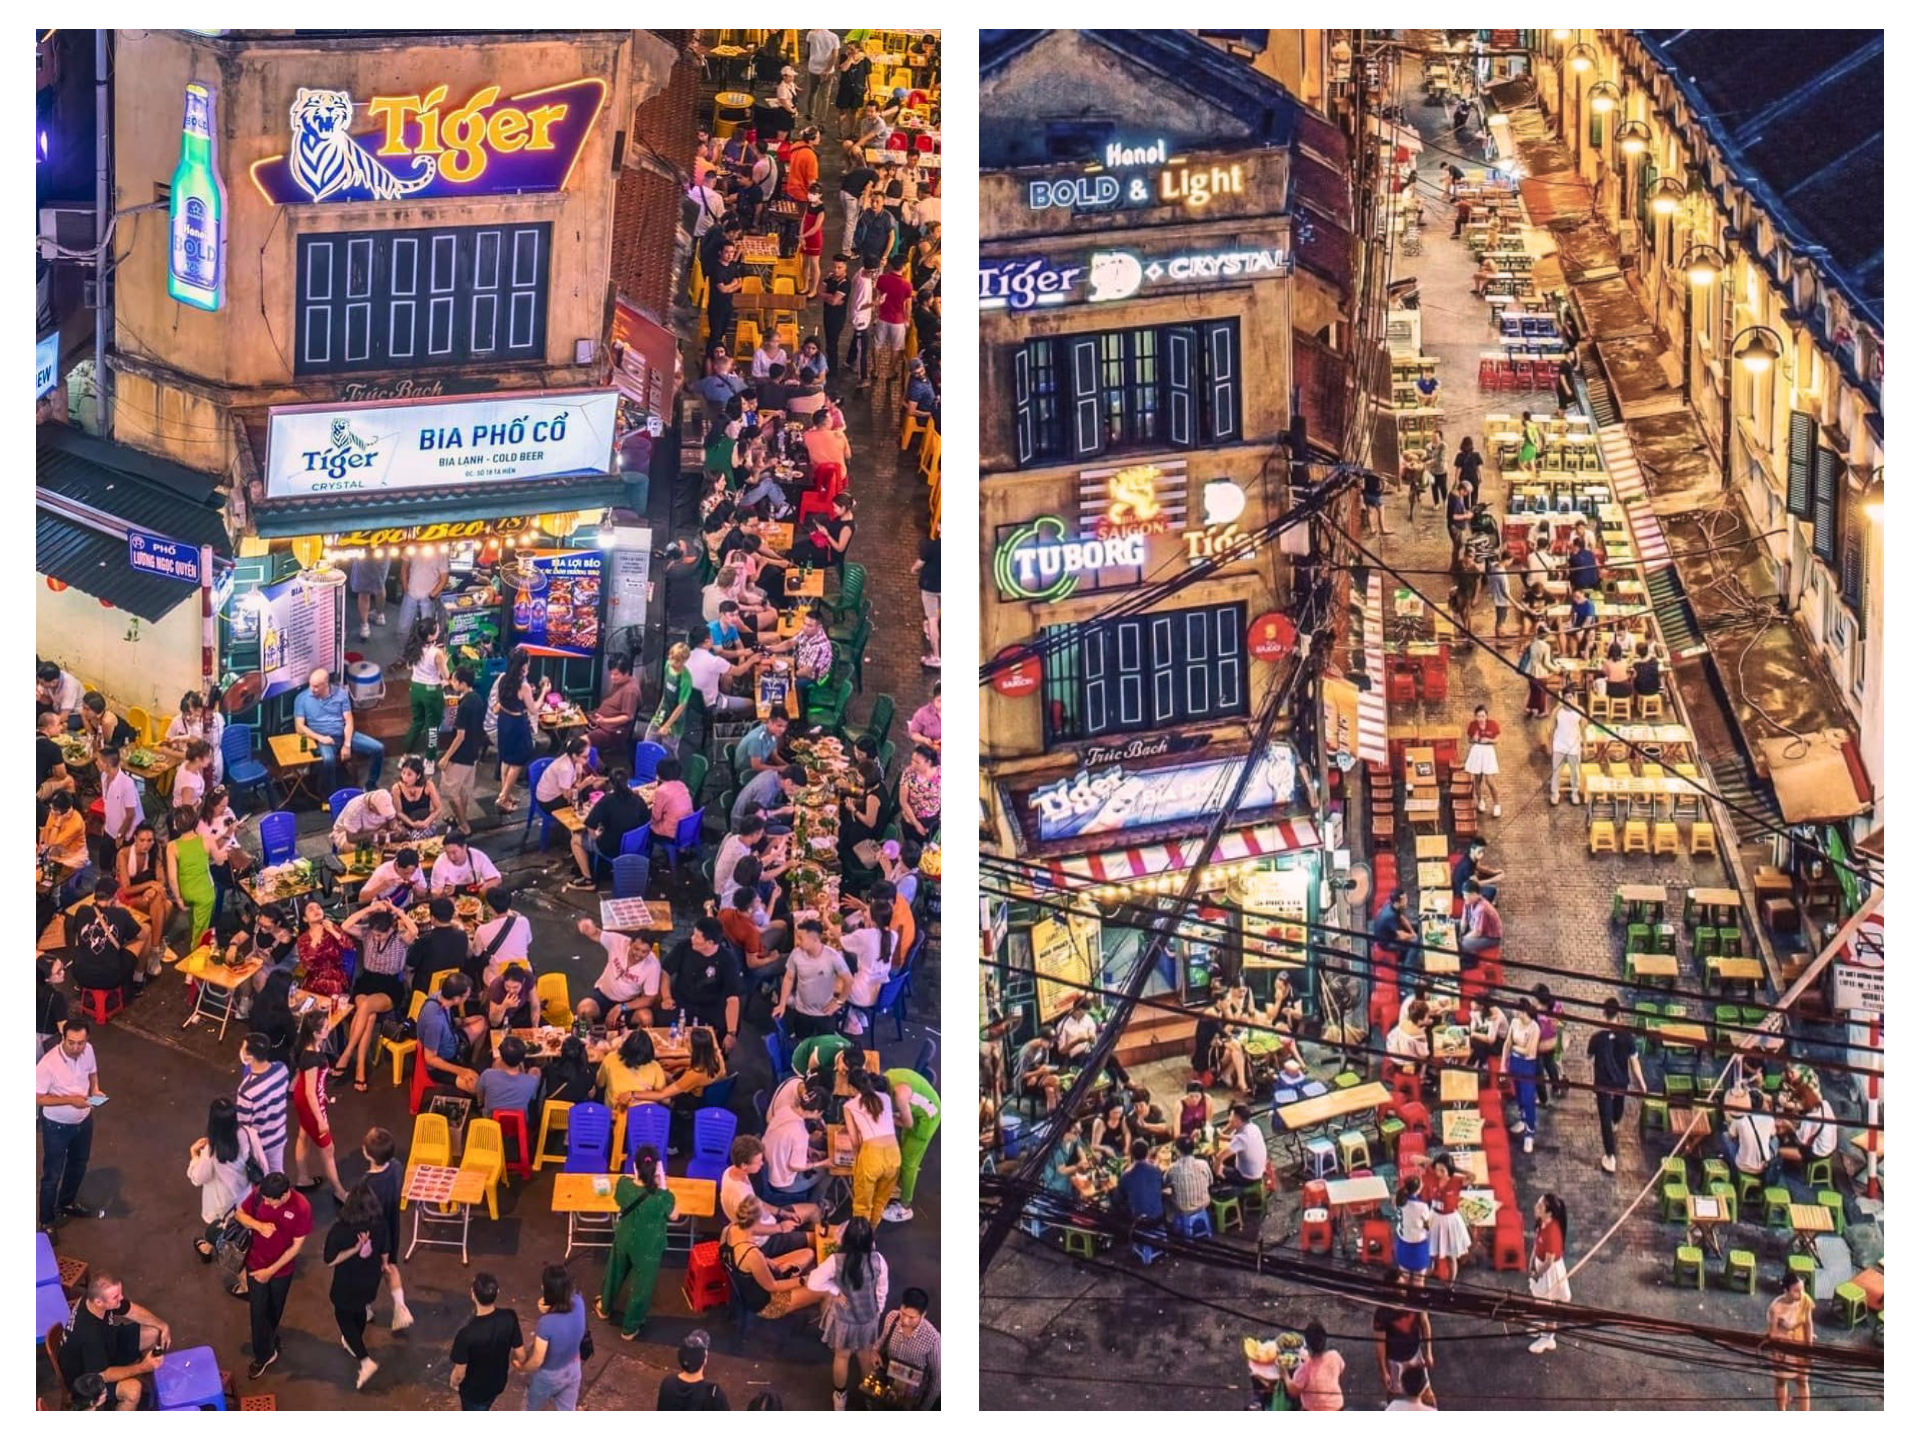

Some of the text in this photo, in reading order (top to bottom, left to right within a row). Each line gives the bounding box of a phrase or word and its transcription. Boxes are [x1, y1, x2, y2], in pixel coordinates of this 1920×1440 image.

[368, 85, 568, 182] Tiger
[1106, 139, 1166, 167] Hanoi
[1030, 164, 1243, 209] BOLD & Light
[183, 224, 207, 240] Hanoi
[174, 234, 216, 262] BOLD
[979, 250, 1290, 308] Tiger CRYSTAL
[419, 411, 569, 451] BIA PHỐ CỔ
[302, 446, 379, 479] Tiger
[439, 457, 455, 467] BIA
[492, 452, 518, 463] COLD
[519, 451, 544, 462] BEER
[311, 480, 365, 491] CRYSTAL
[1097, 520, 1165, 541] SAIGON
[152, 543, 177, 556] PHỐ
[1013, 533, 1145, 581] TUBORG
